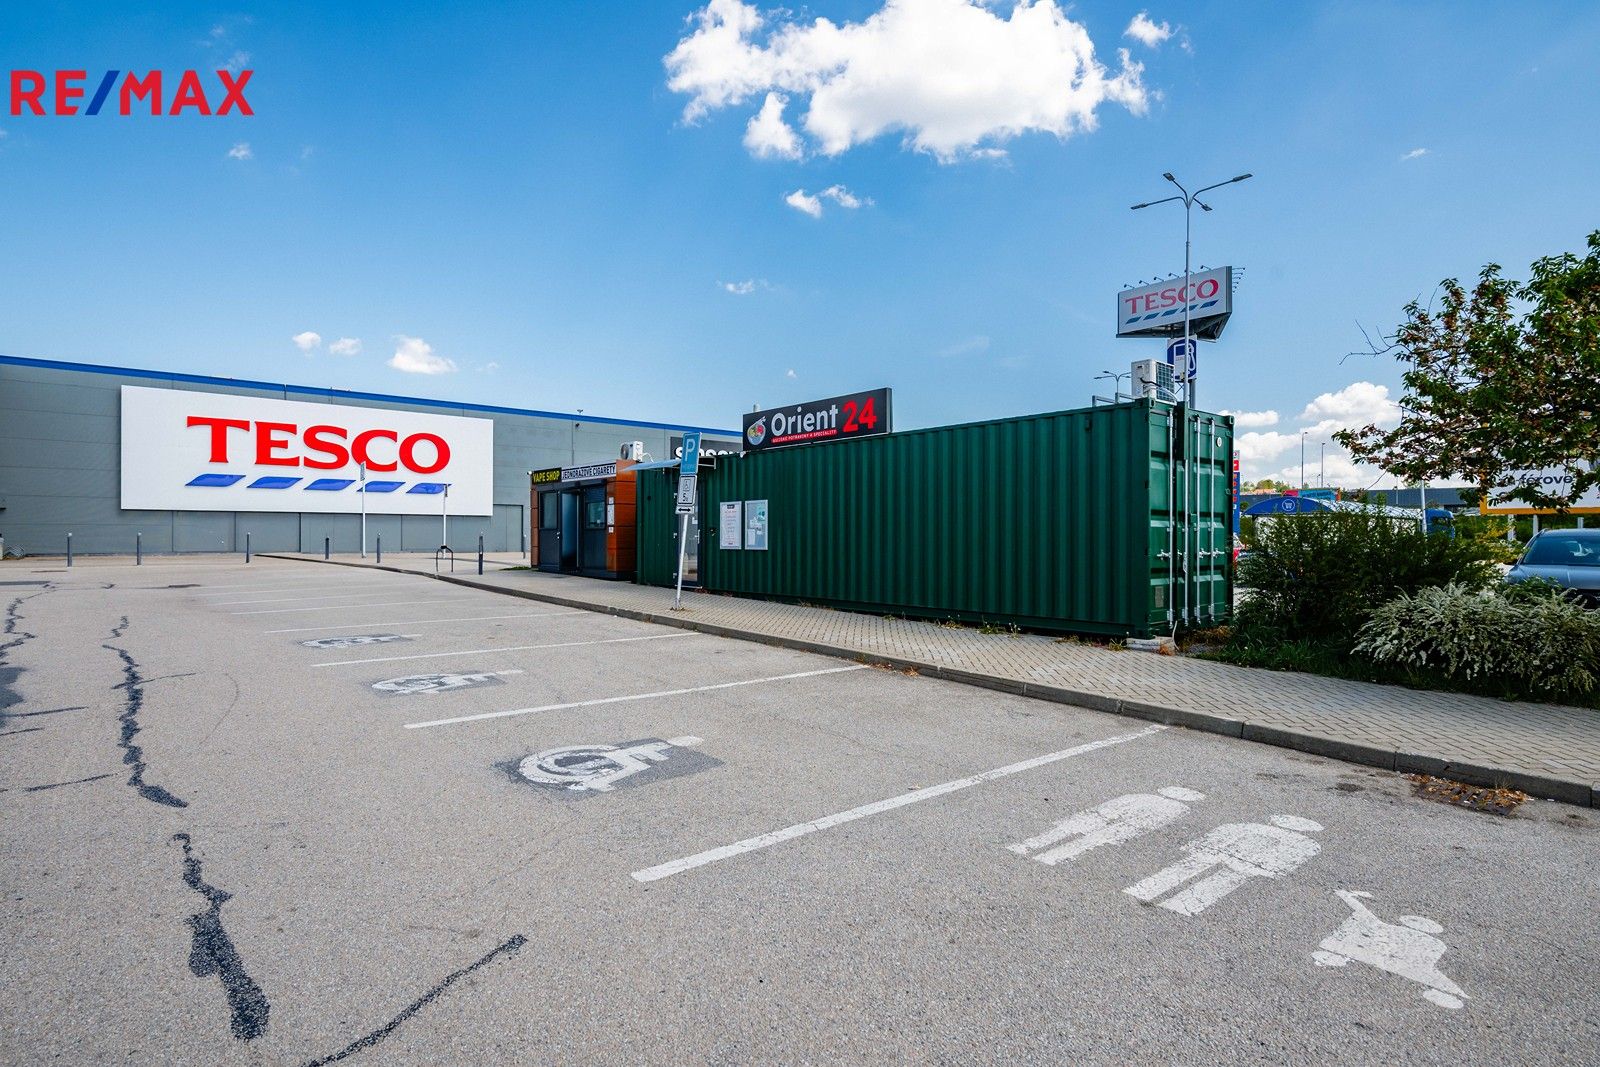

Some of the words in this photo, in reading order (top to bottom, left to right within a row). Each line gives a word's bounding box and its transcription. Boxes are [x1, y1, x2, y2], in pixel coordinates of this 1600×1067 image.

[1125, 278, 1219, 315] TESCO
[771, 404, 838, 437] Orient
[842, 396, 878, 433] 24
[187, 416, 451, 474] TESCO
[685, 438, 696, 462] P
[533, 471, 546, 483] VAPE
[546, 470, 560, 481] SHOP
[593, 464, 616, 476] CIGARETY
